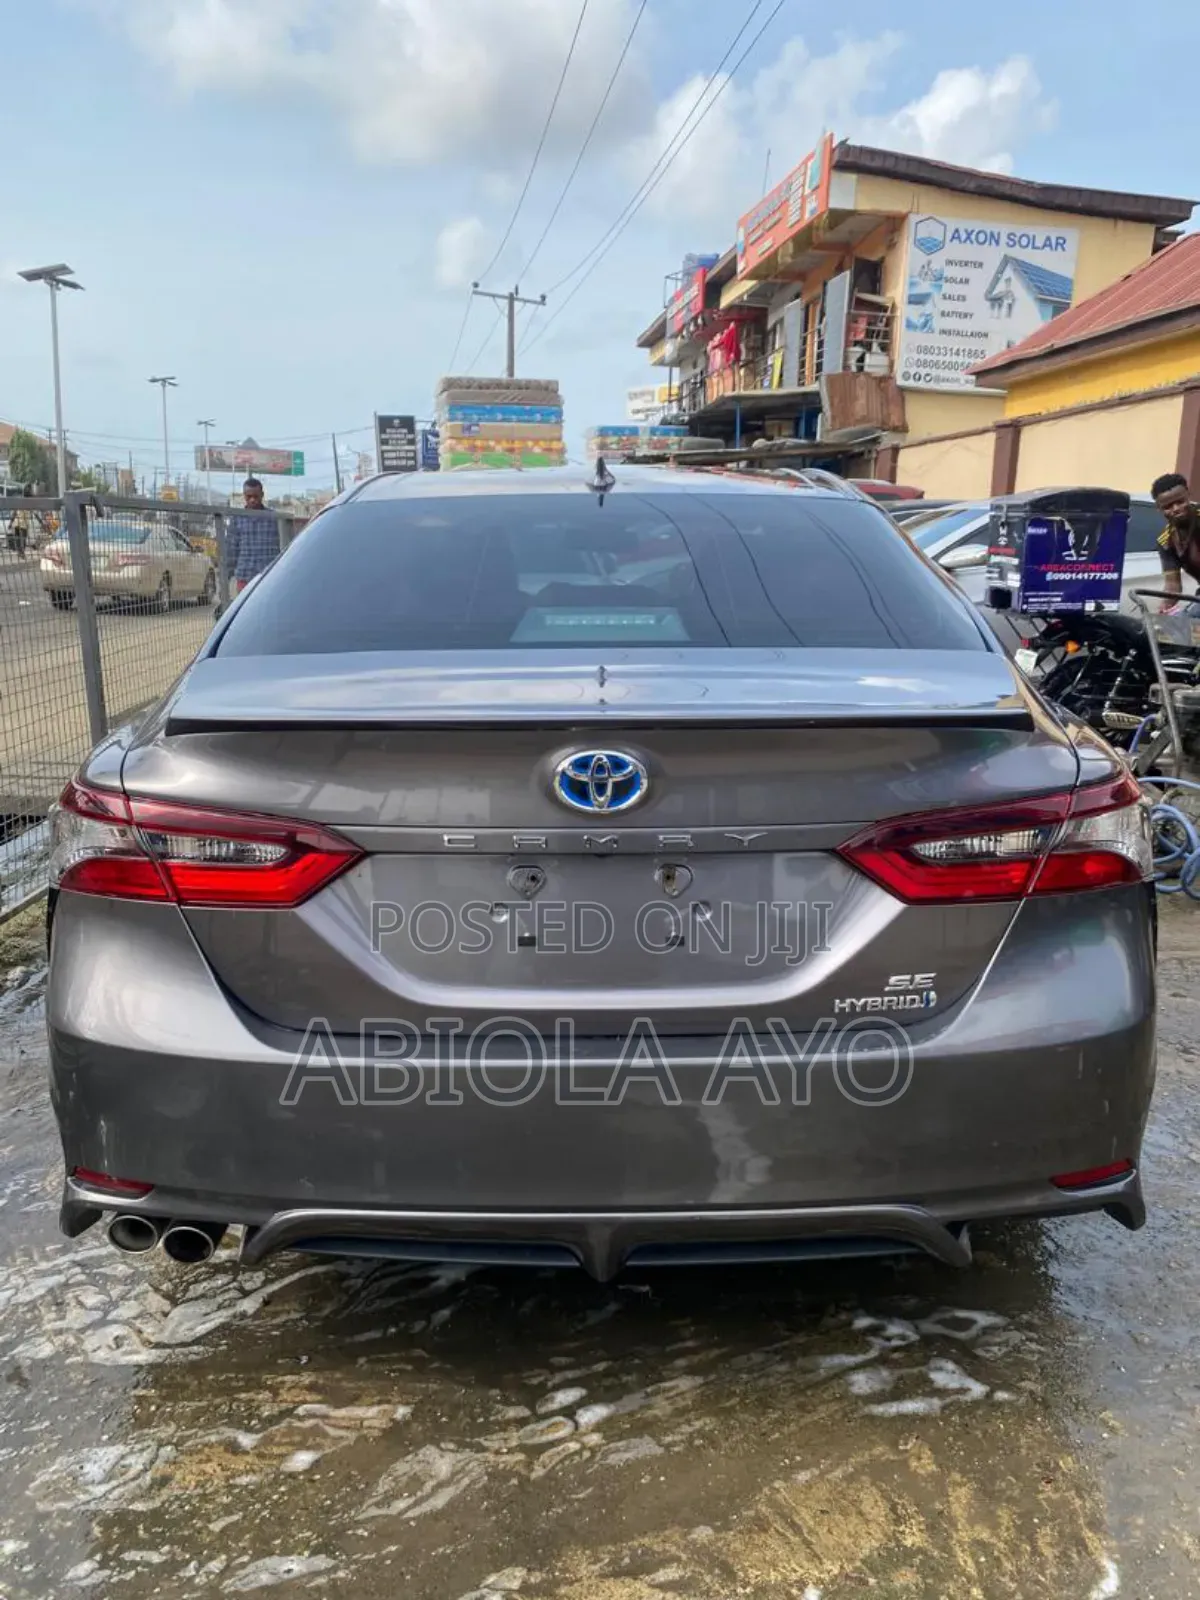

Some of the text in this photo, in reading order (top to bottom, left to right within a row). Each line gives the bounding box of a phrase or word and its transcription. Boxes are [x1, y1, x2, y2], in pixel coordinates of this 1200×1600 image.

[949, 227, 1067, 252] AXON SOLAR
[945, 259, 984, 269] INVERTER
[944, 276, 970, 285] SOLAR
[942, 293, 967, 302] SALES
[940, 310, 974, 320] BATTERY
[443, 832, 768, 848] CAMRY
[884, 972, 937, 991] SE
[834, 994, 920, 1013] HYBRID
